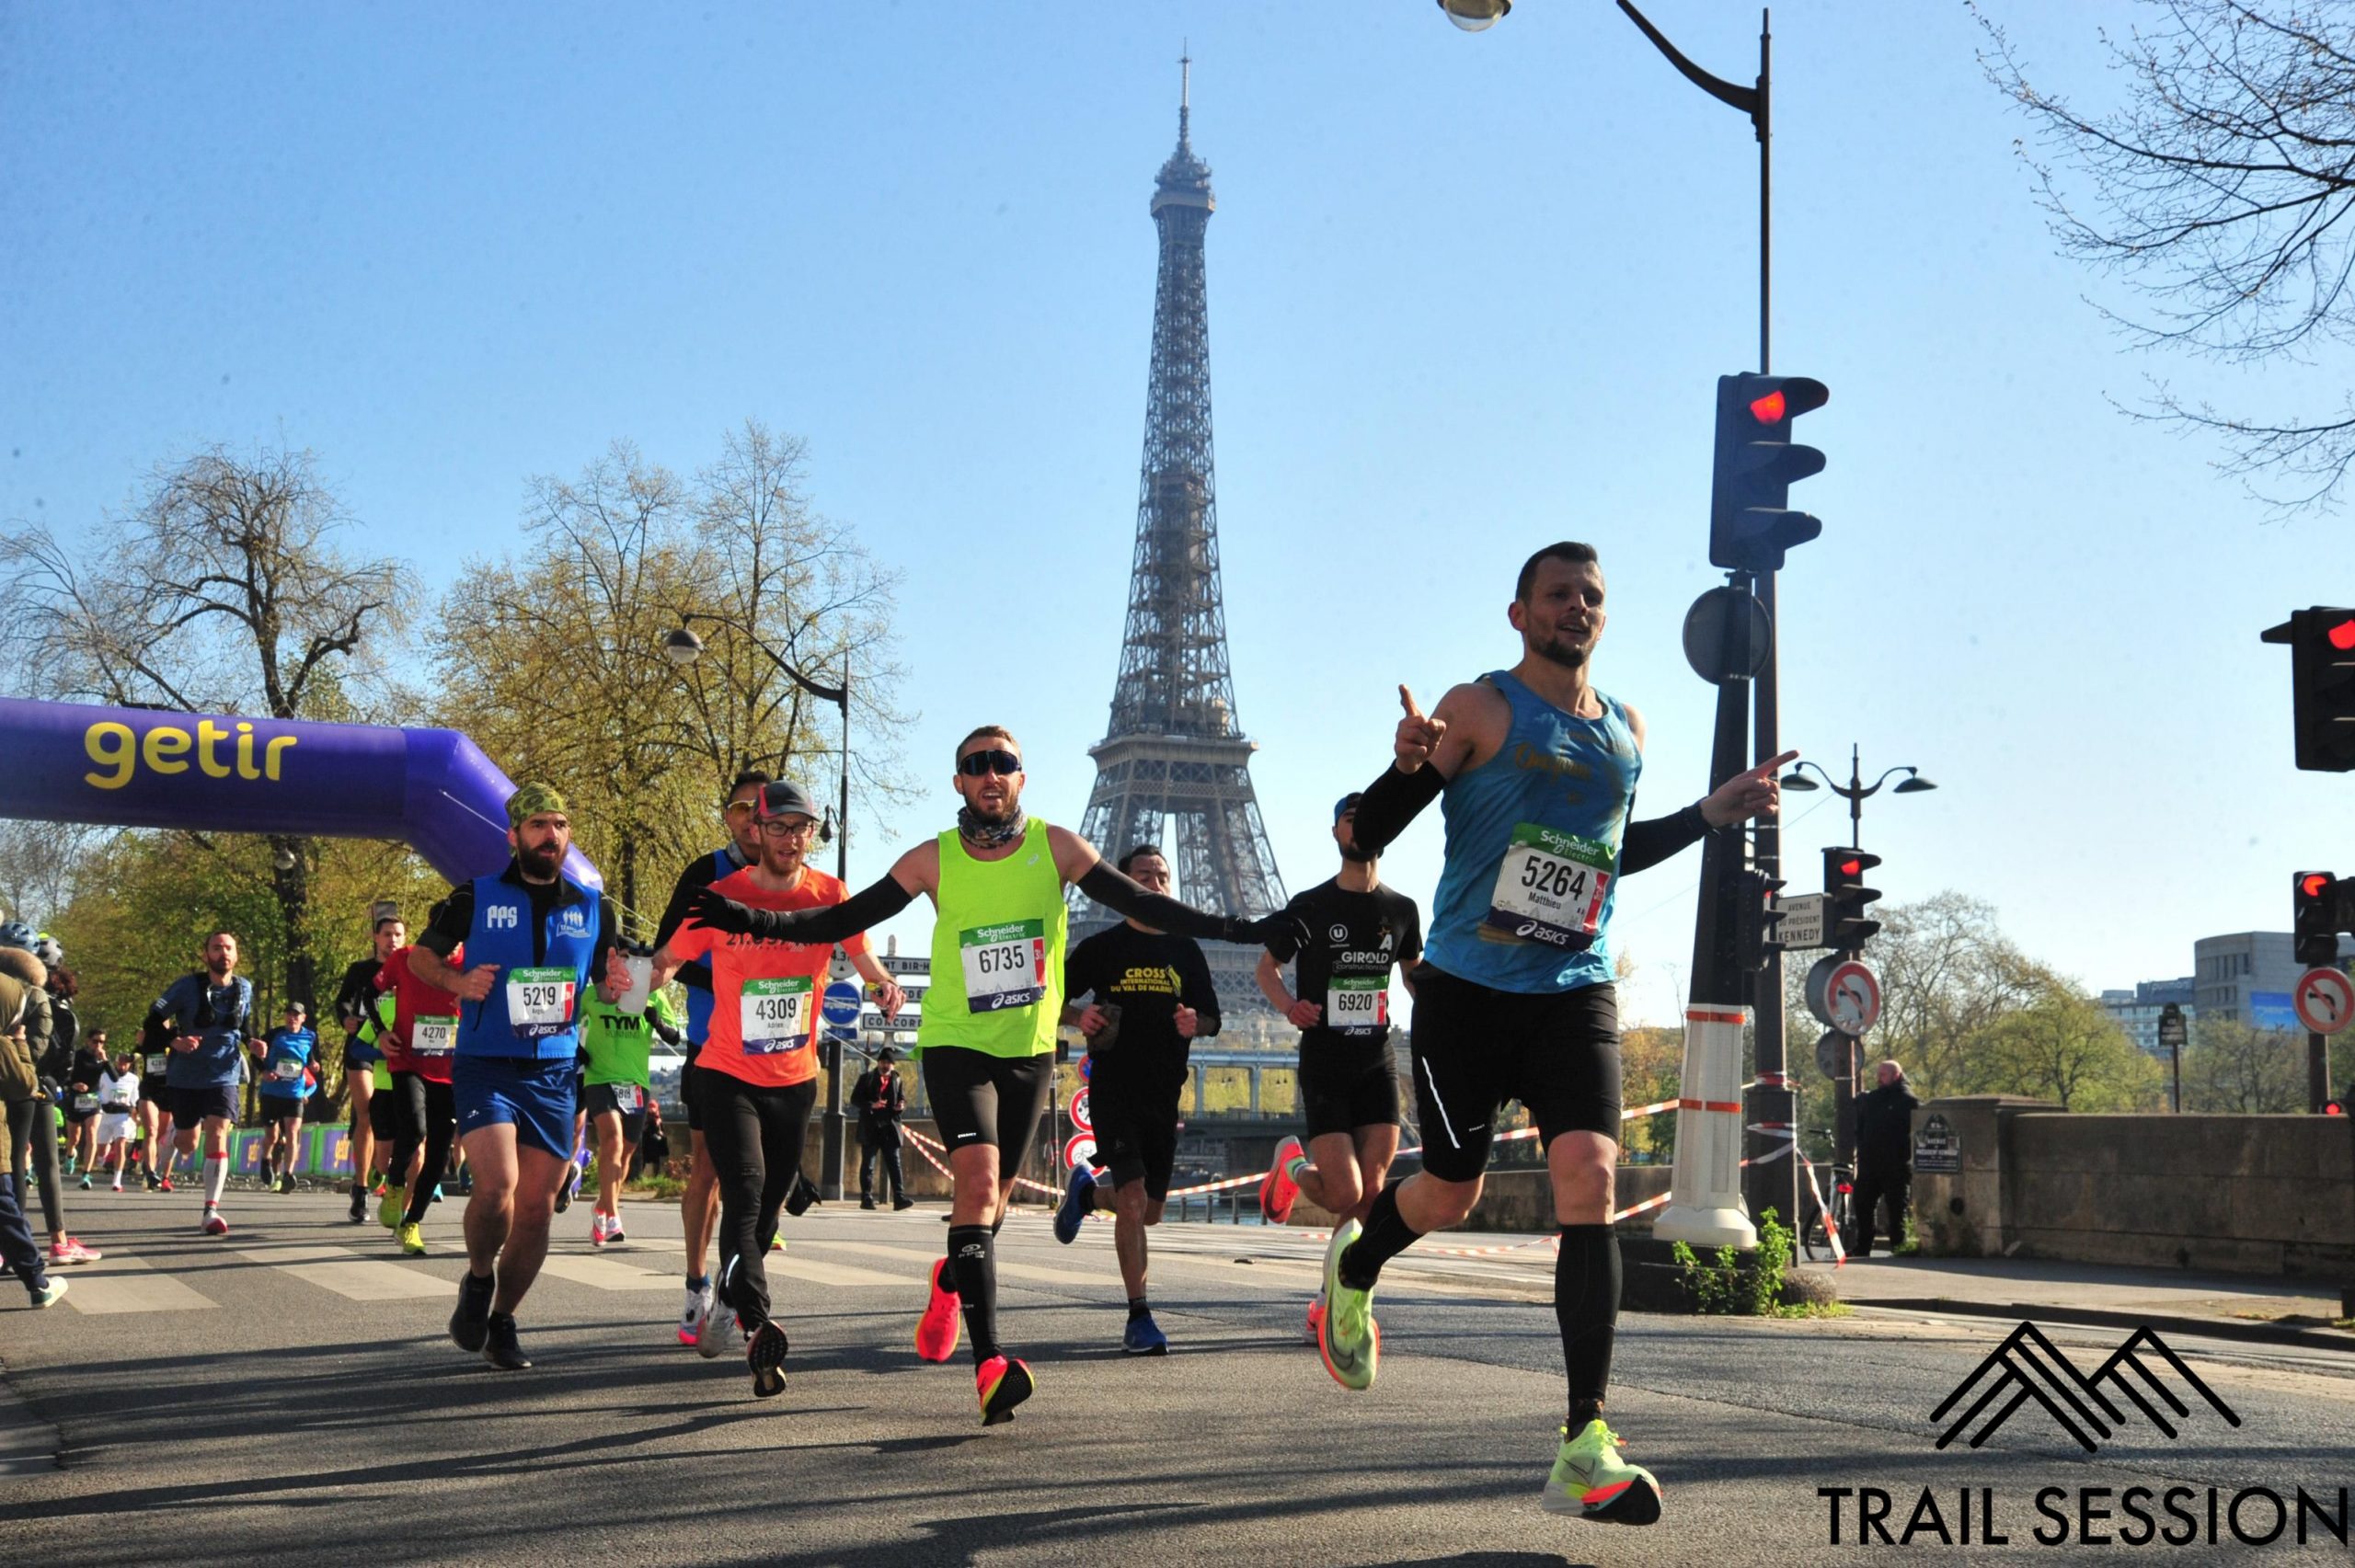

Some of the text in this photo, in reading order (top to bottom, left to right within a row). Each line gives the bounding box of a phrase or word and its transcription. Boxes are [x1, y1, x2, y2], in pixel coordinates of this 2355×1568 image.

[84, 720, 297, 789] getir
[1540, 830, 1600, 856] Schneider
[1521, 854, 1587, 901] 5264
[1527, 891, 1562, 910] Matthieu
[1787, 901, 1810, 911] AVENUE
[977, 924, 1025, 939] Schneider
[1534, 926, 1570, 945] asics
[1777, 927, 1820, 943] KENNEDY
[979, 944, 1025, 974] 6735
[1341, 951, 1389, 964] GIROLD
[523, 969, 562, 979] Schneider
[1125, 967, 1166, 979] CROSS
[758, 979, 800, 990] Schneider
[1120, 978, 1170, 986] INTERNATIONAL
[1122, 984, 1136, 992] VAL
[523, 986, 556, 1006] 5219
[1004, 992, 1030, 1006] asics
[1338, 994, 1373, 1011] 6920
[755, 997, 797, 1020] 4309
[537, 1024, 557, 1035] asics
[599, 1014, 640, 1030] TYM
[421, 1026, 446, 1038] 4270
[775, 1038, 795, 1050] asics
